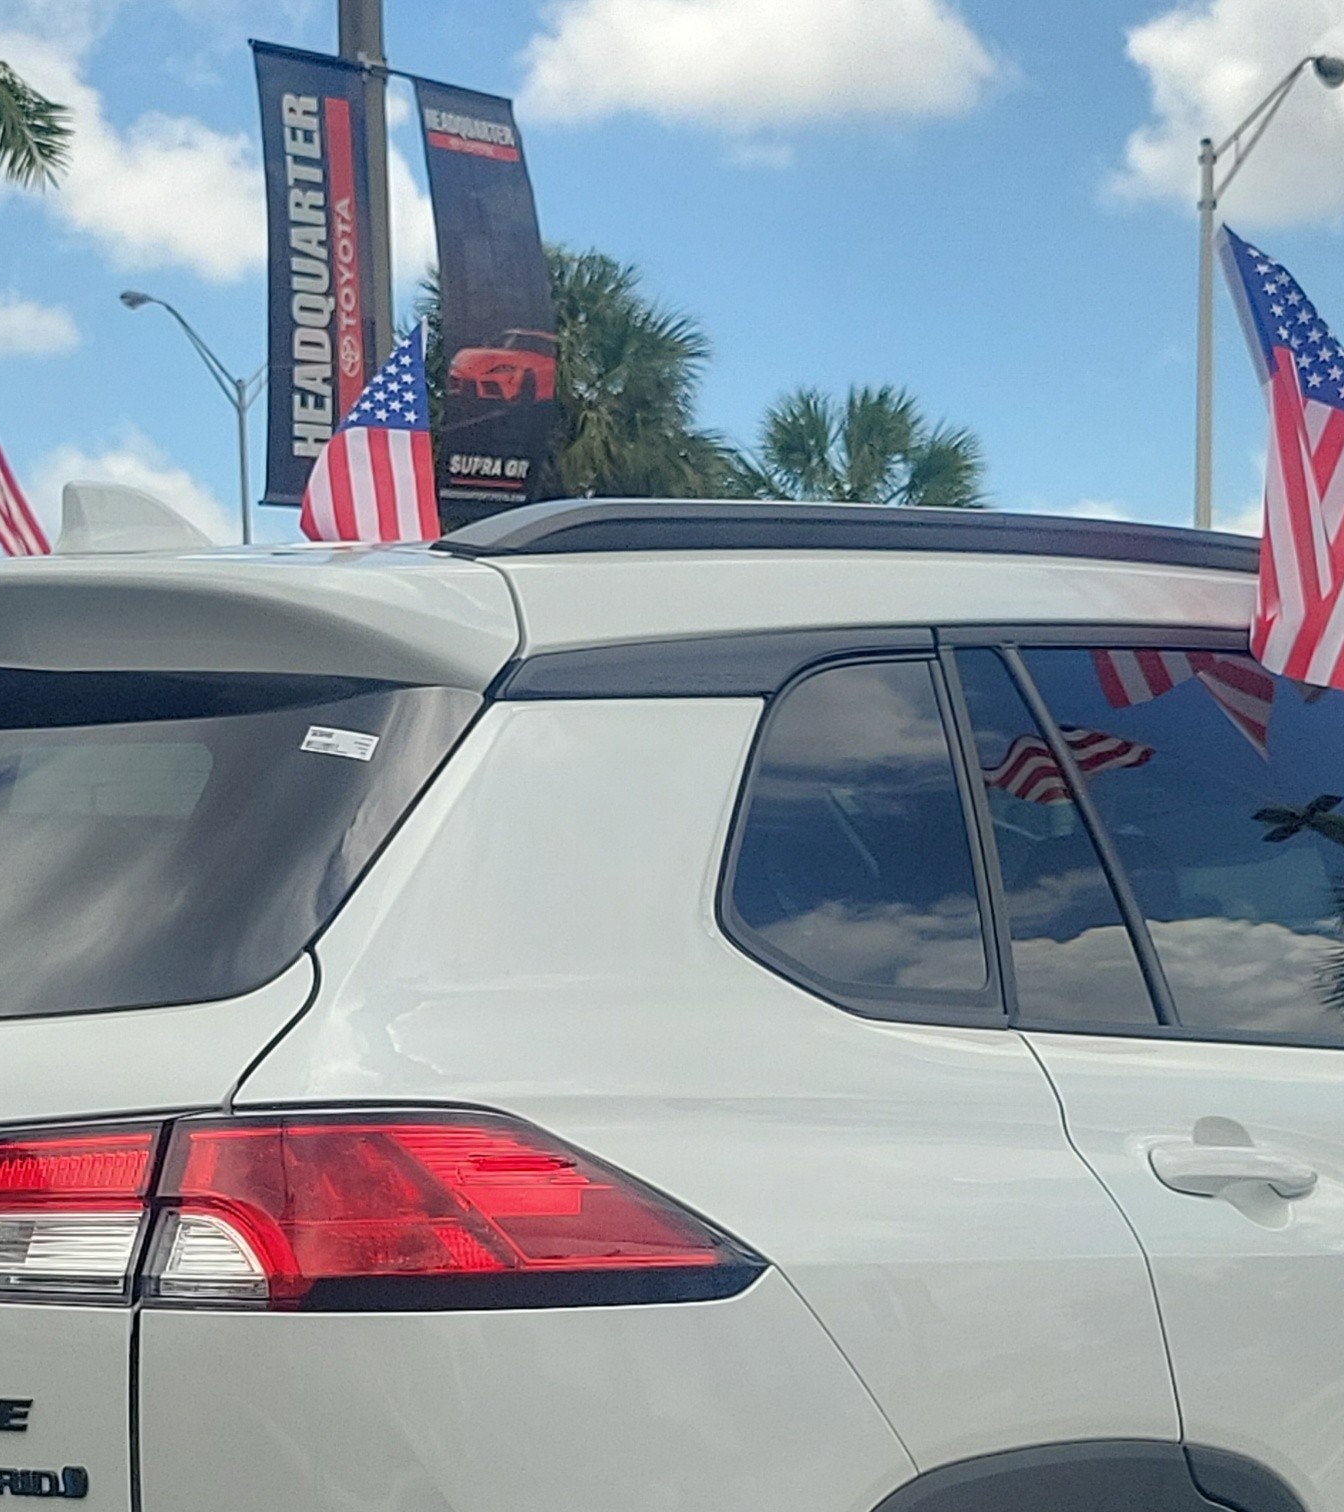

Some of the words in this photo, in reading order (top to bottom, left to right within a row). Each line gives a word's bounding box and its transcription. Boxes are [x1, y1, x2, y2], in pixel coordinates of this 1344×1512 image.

[282, 93, 335, 457] HEADQUARTER
[334, 198, 358, 332] TOYOTA
[449, 454, 503, 477] SUPRA
